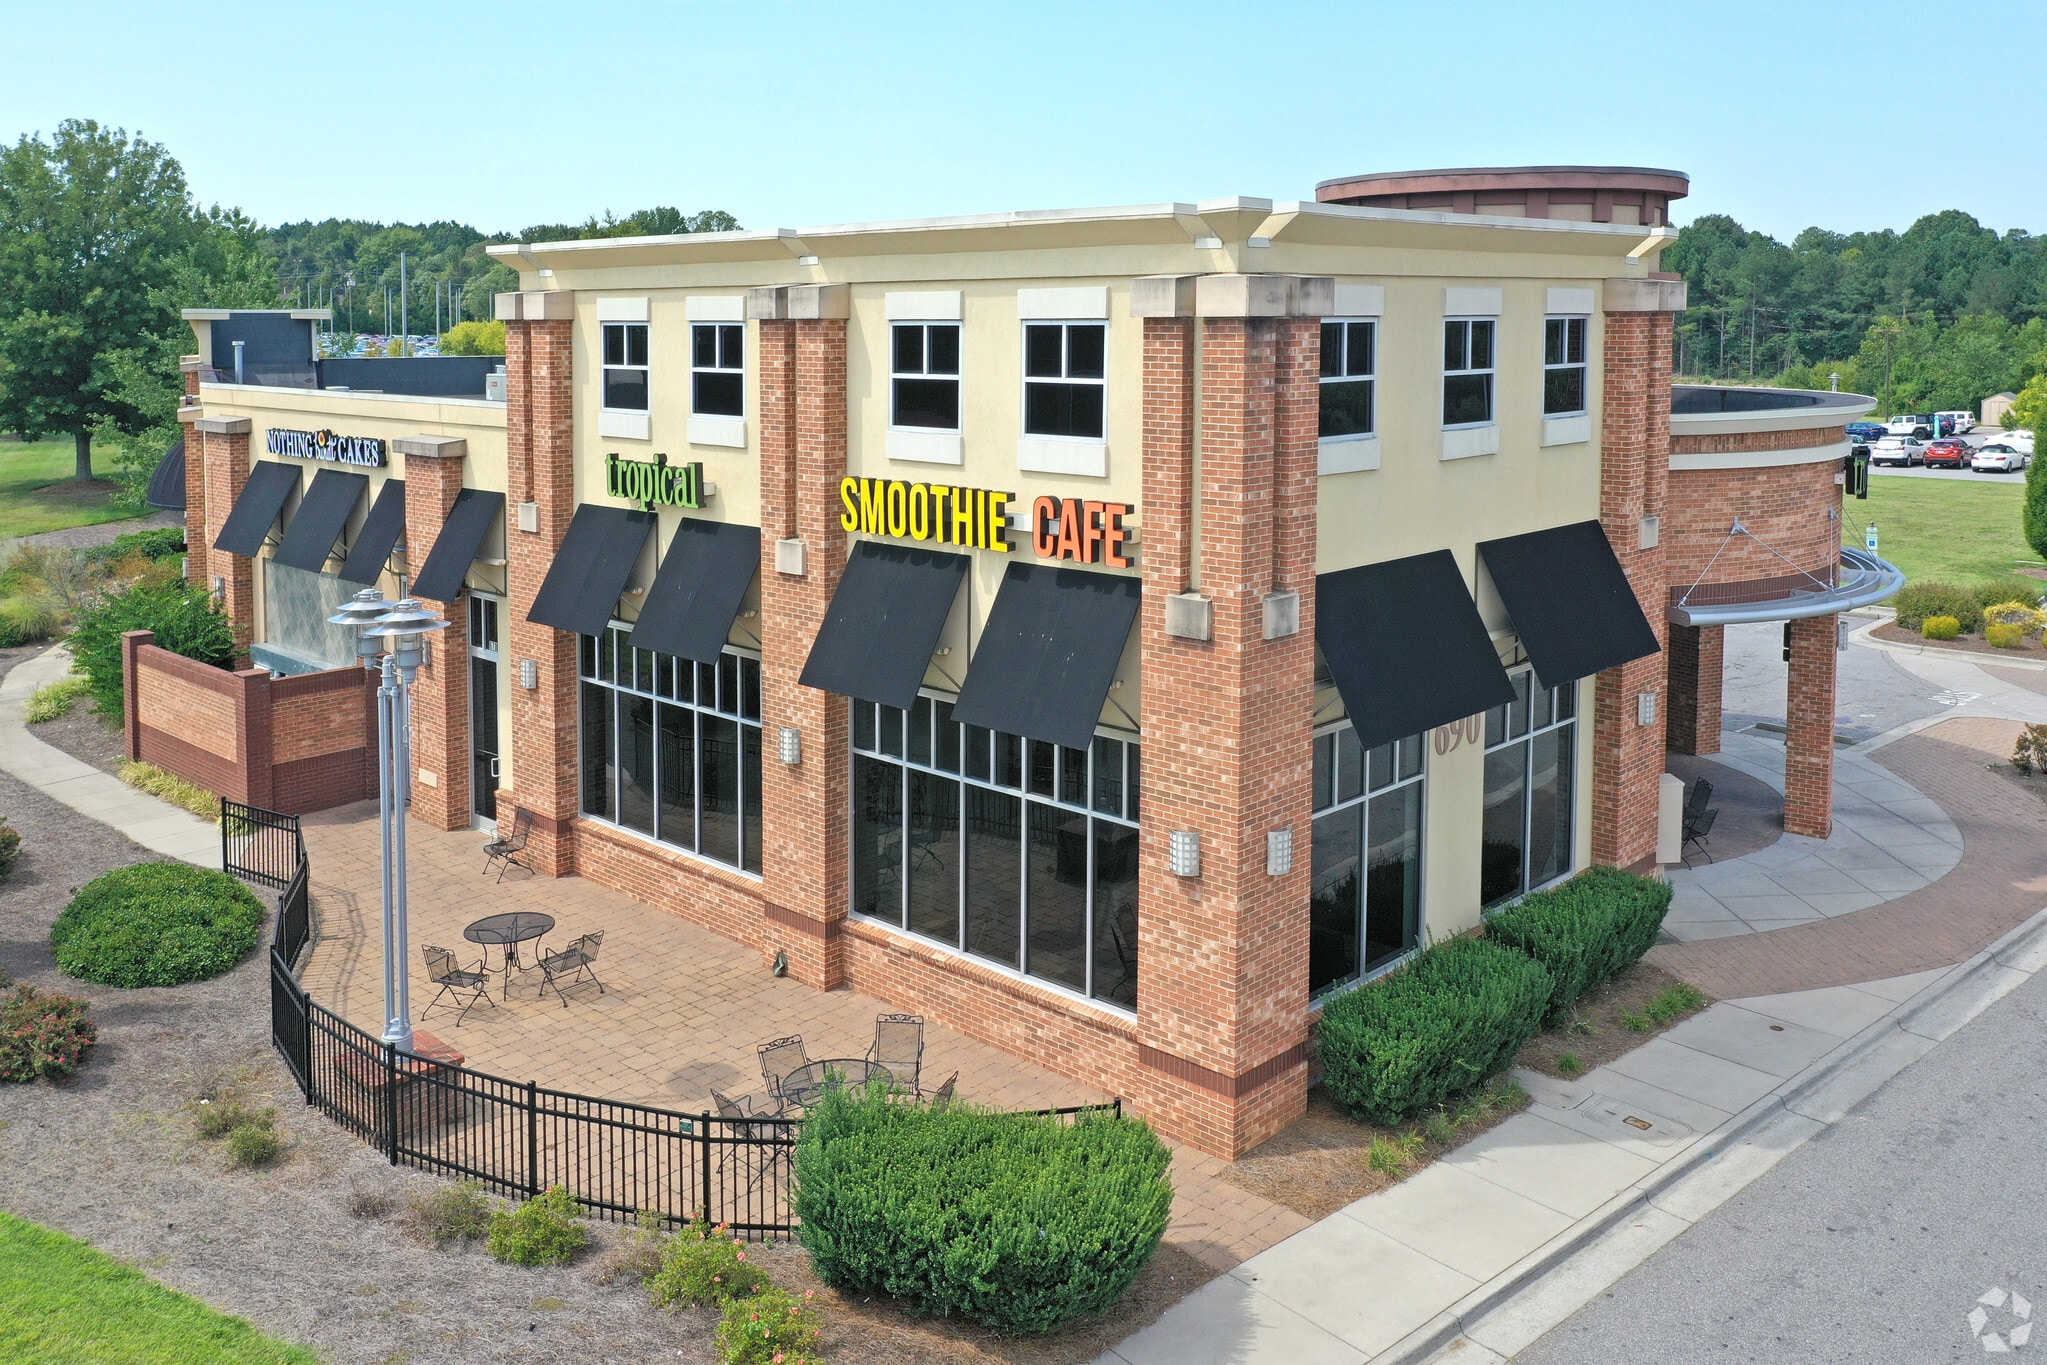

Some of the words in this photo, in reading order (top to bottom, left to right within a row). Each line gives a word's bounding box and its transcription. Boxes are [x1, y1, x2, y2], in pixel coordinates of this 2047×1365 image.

[266, 429, 313, 459] NOTHING
[338, 437, 380, 467] CAKES
[605, 453, 700, 512] tropical
[840, 476, 1011, 553] SMOOTHIE
[1032, 495, 1130, 569] CAFE
[1434, 713, 1481, 756] 690
